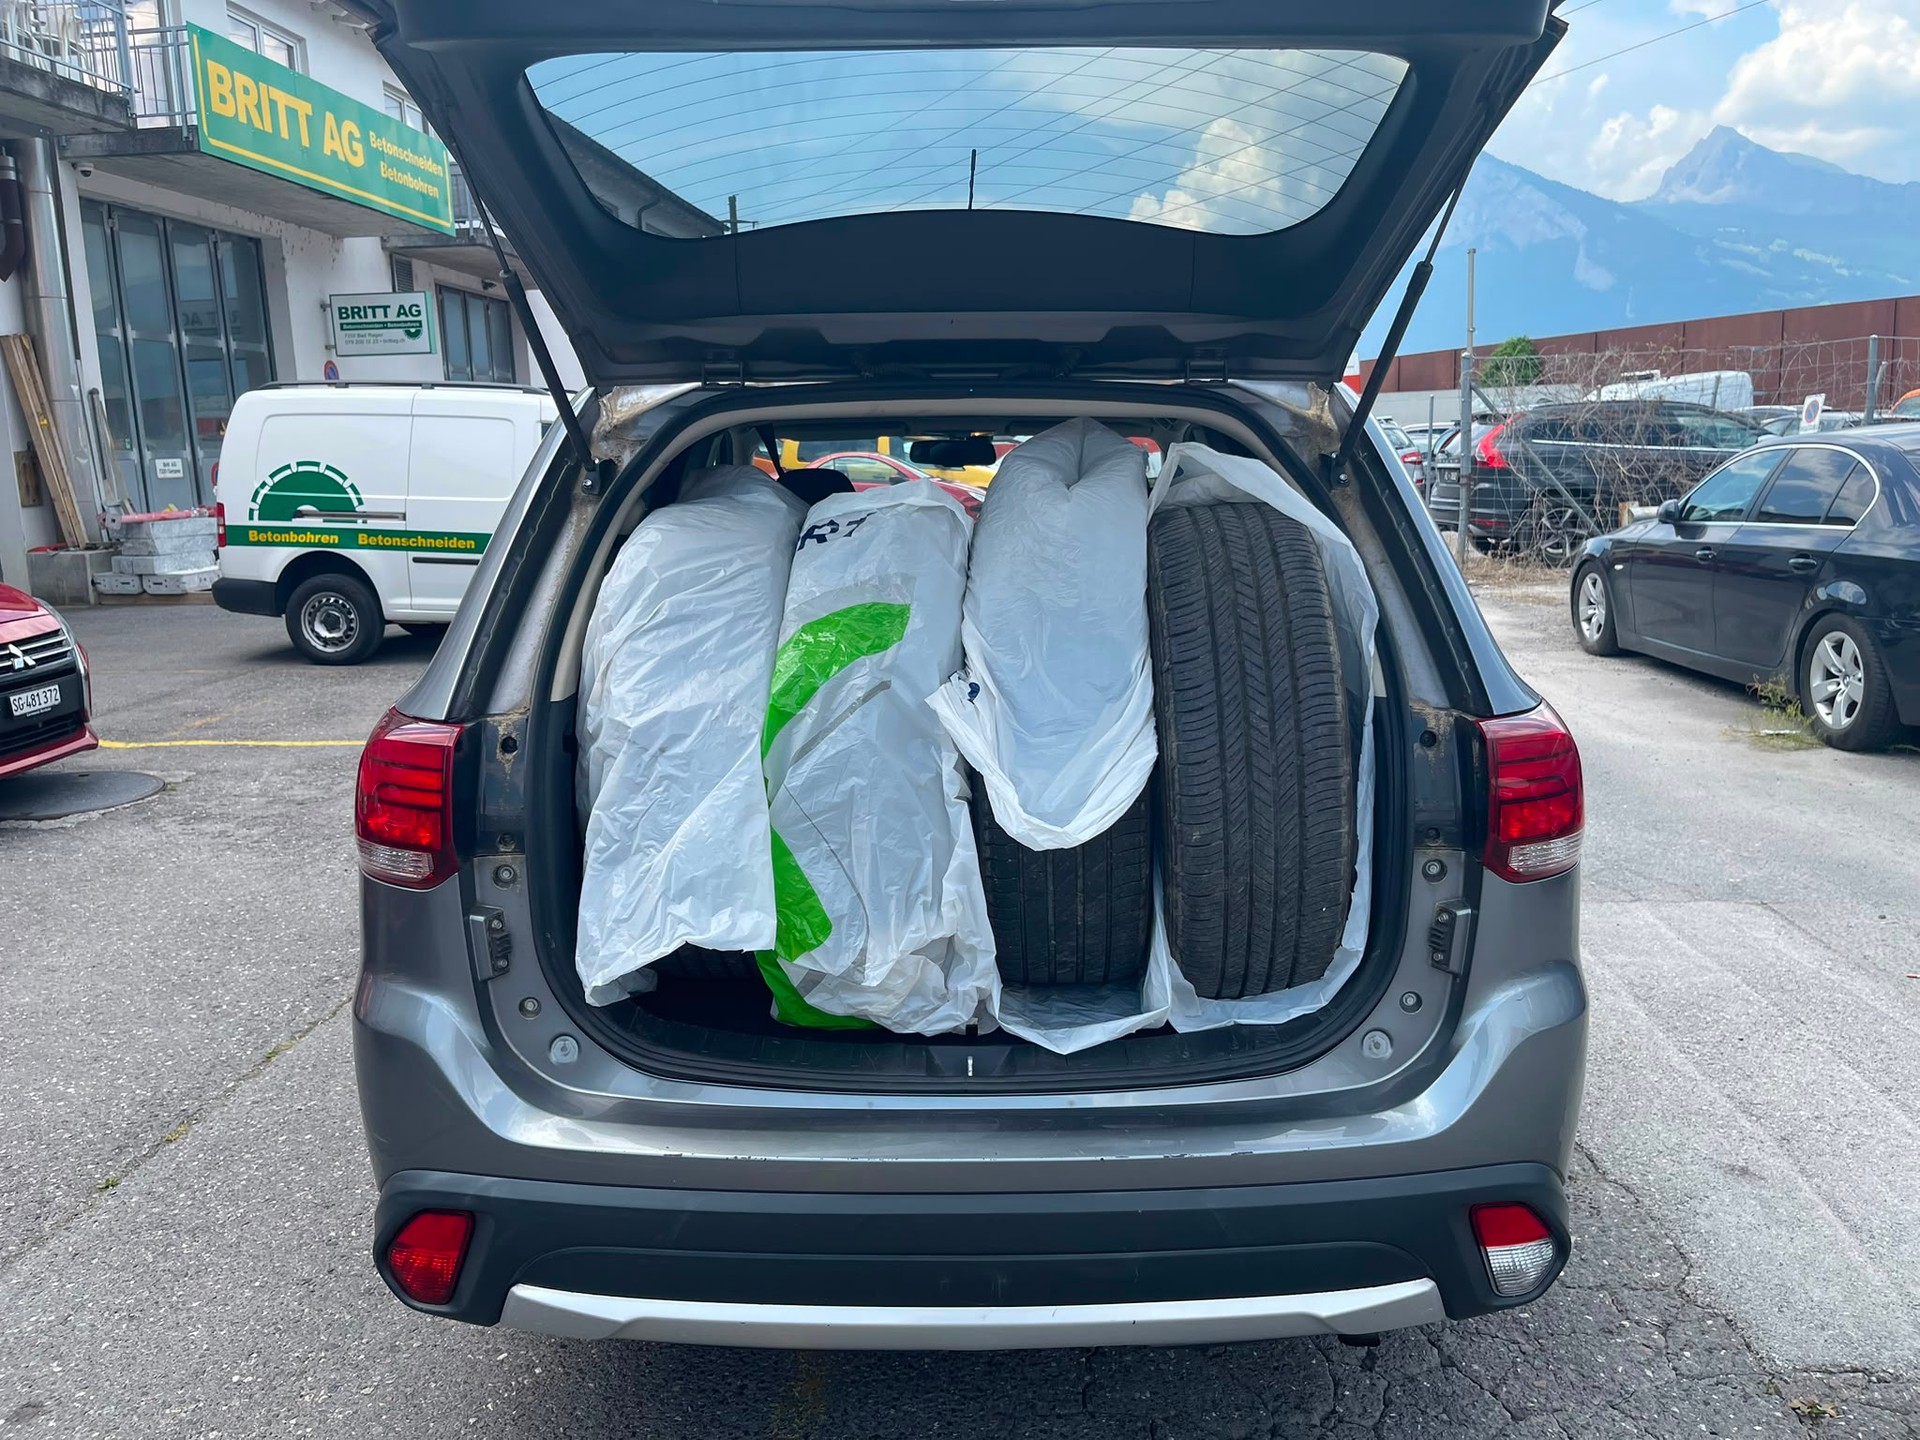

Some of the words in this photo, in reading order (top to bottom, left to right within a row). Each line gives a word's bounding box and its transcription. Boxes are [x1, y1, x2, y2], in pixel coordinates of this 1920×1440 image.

[206, 59, 313, 148] BRITT
[323, 111, 365, 168] AG
[369, 131, 443, 177] Betonschneiden
[380, 161, 440, 198] Betonbohren
[338, 305, 391, 320] BRITT
[396, 304, 422, 318] AG
[248, 530, 339, 544] Betonbohren
[357, 533, 476, 549] Betonschneiden
